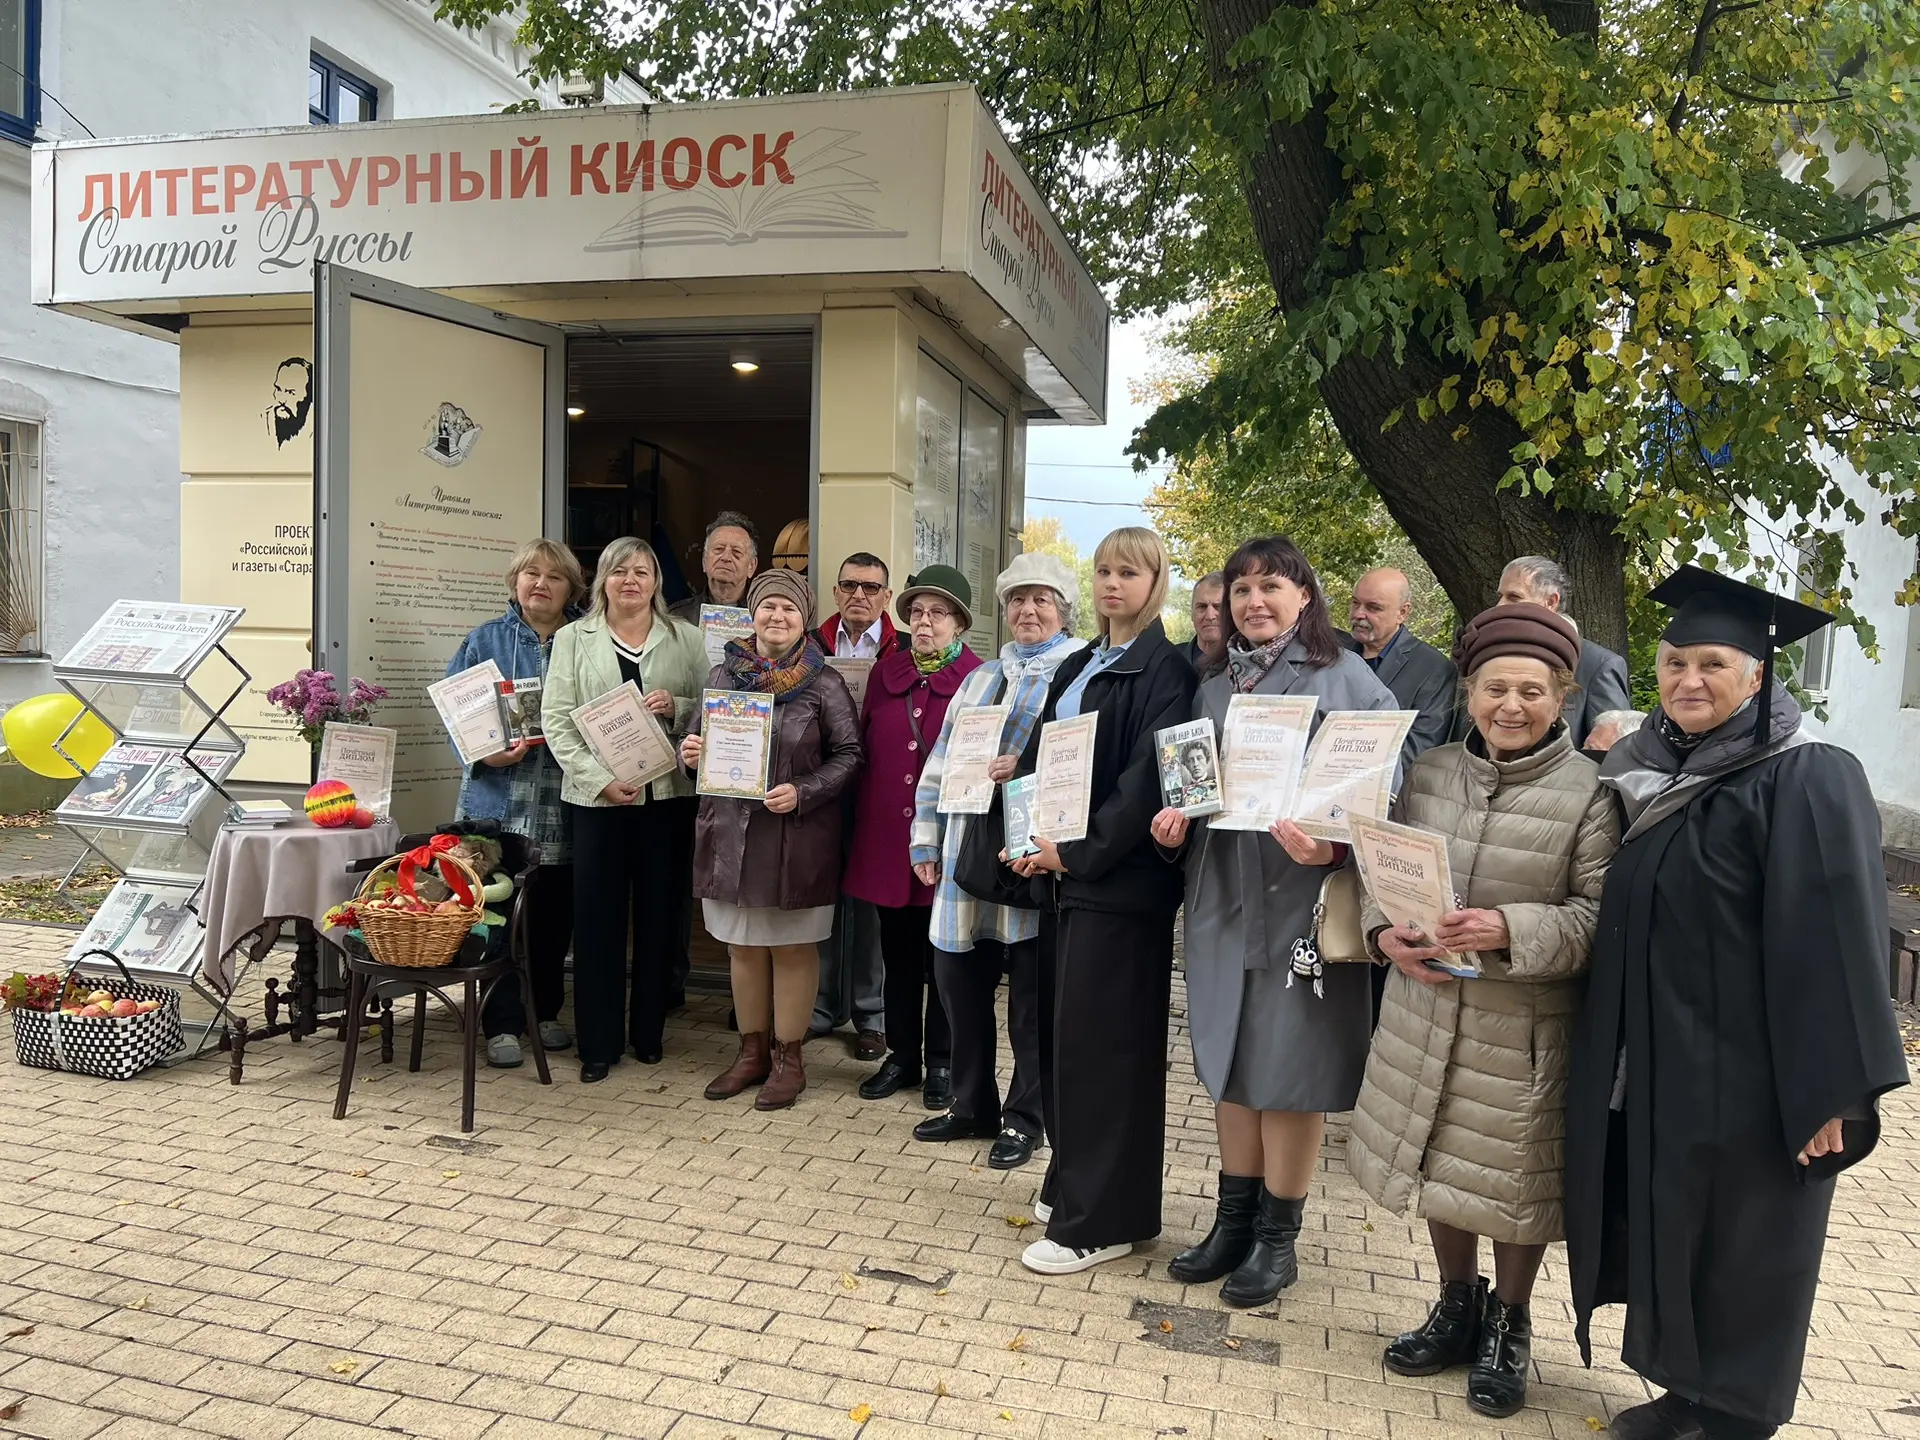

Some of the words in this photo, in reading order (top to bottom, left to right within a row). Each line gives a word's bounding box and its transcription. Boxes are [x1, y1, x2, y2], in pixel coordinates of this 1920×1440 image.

[78, 135, 548, 222] ЛИТЕРАТУРНЫЙ
[570, 131, 795, 197] КИОСК
[78, 206, 238, 284] Старой
[258, 192, 414, 277] Руссы
[981, 147, 1077, 317] ЛИТЕРАТУРНЫЙ
[980, 191, 1024, 292] Старой
[1025, 248, 1056, 332] Руссы
[275, 525, 313, 539] ПРОЕК
[239, 541, 308, 556] «Российской
[240, 562, 278, 573] газеты
[114, 617, 175, 631] Российская
[1328, 744, 1377, 754] ДИПЛОМ
[1377, 857, 1425, 880] ДИПЛОМ
